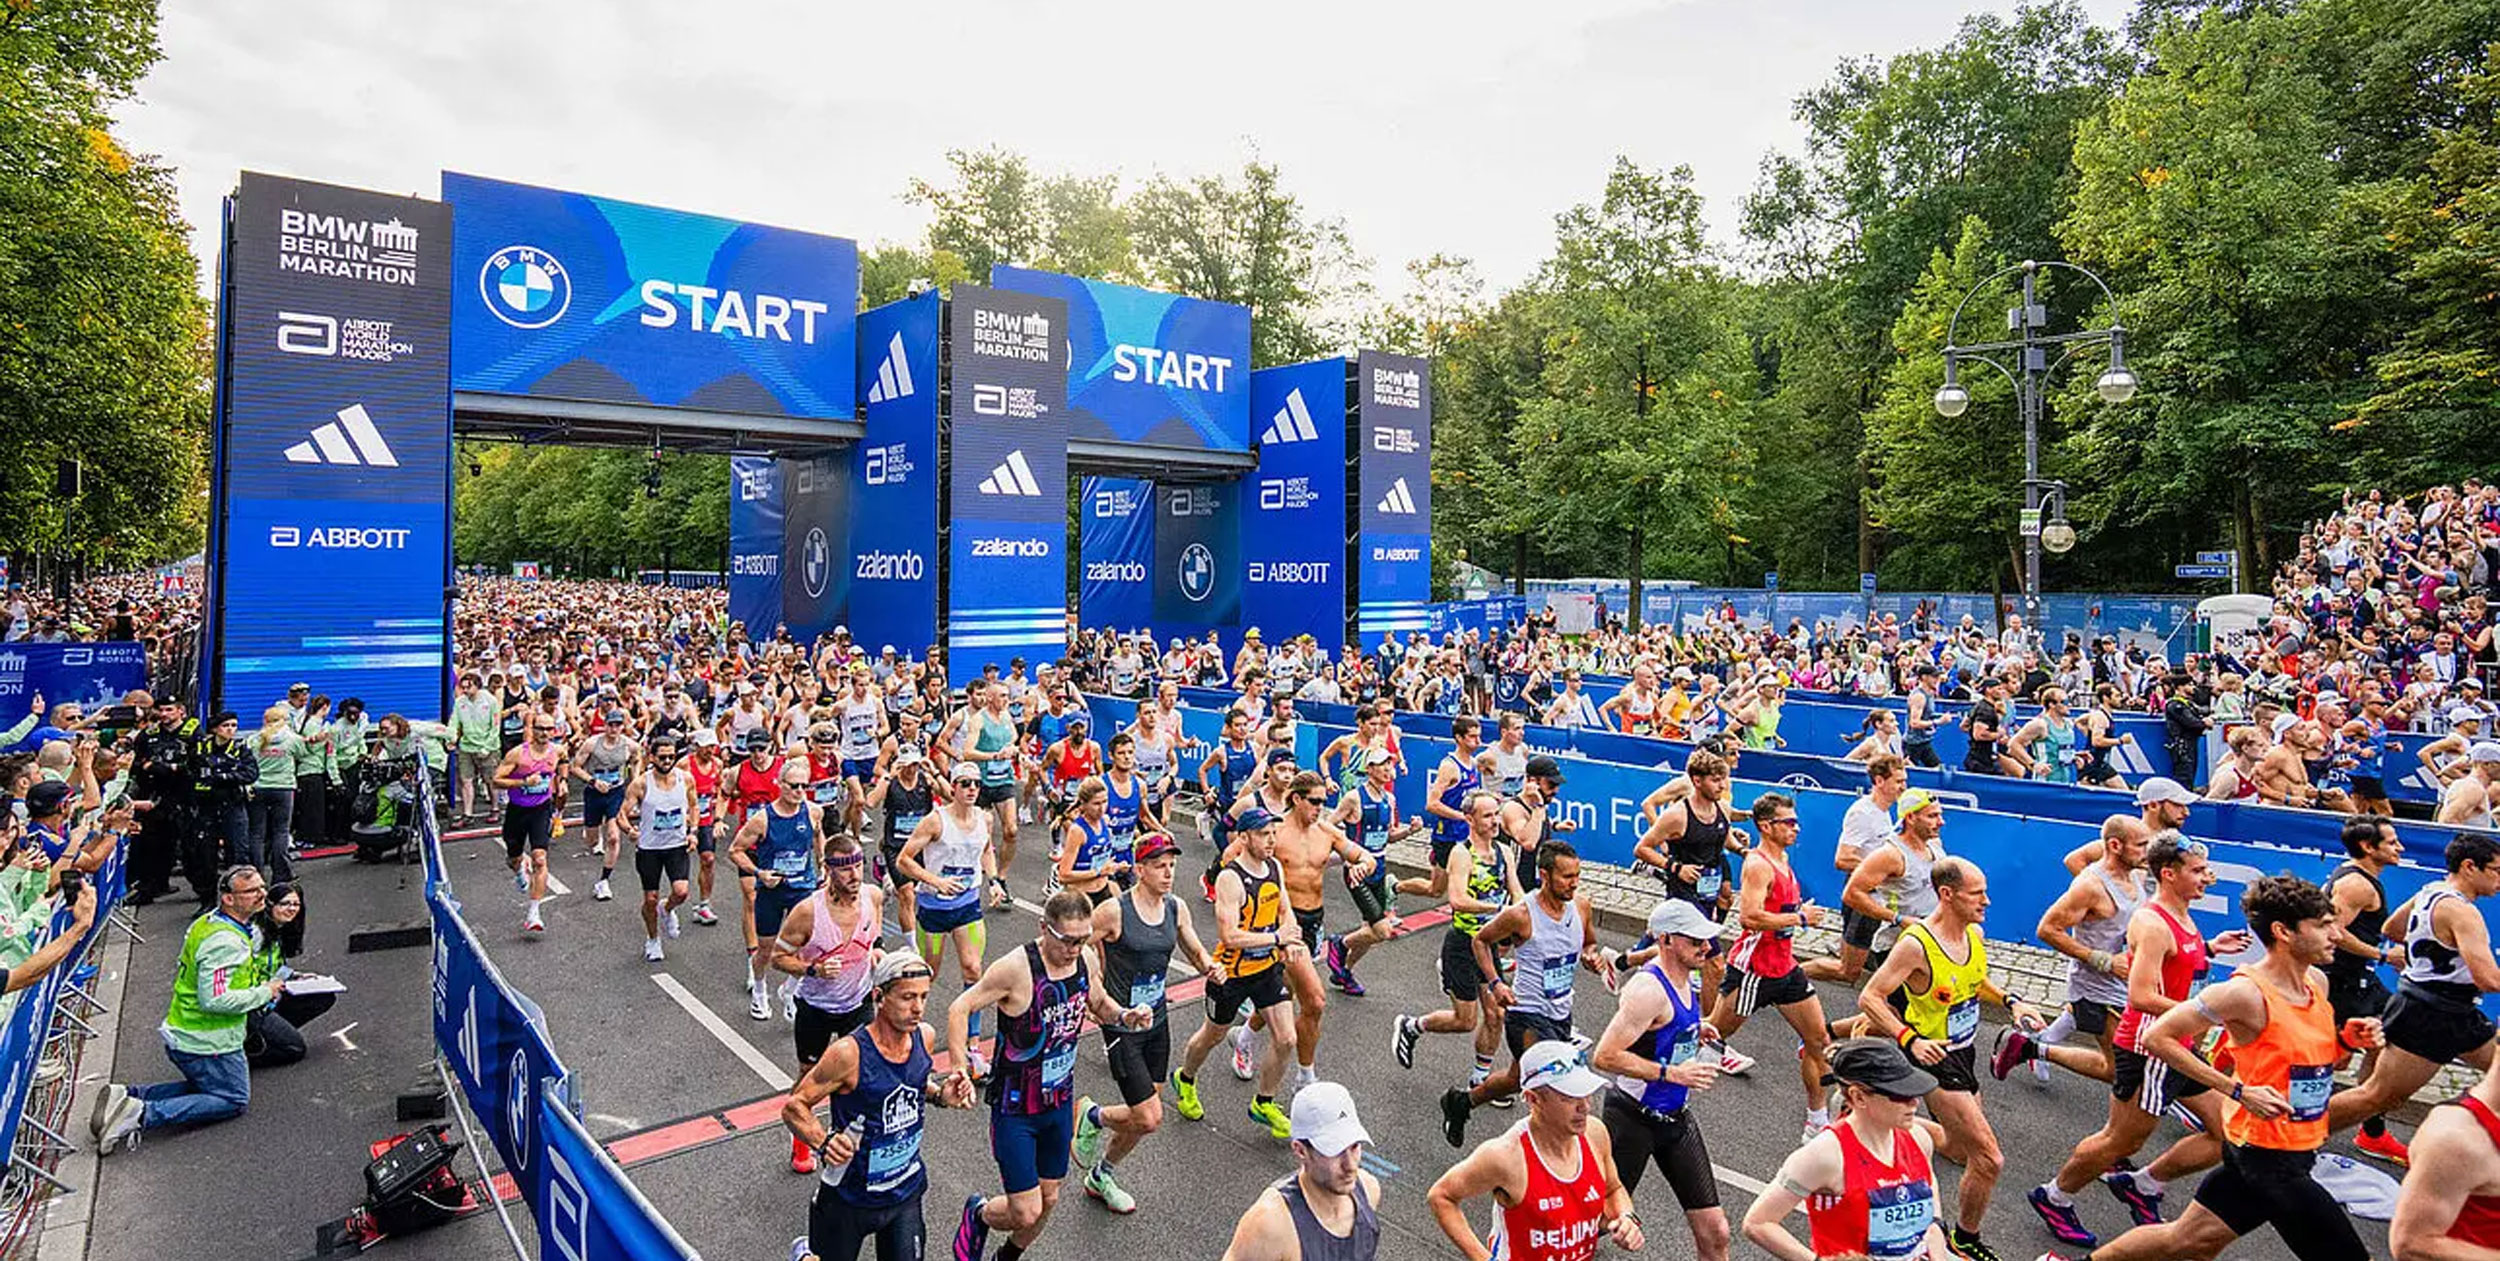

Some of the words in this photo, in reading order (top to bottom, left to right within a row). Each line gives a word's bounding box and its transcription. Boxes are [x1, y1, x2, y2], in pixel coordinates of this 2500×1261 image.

[281, 209, 368, 243] BMW
[280, 235, 368, 261] BERLIN
[279, 253, 416, 286] MARATHON
[493, 250, 560, 278] BMW
[640, 279, 827, 344] START
[974, 309, 1021, 332] BMW
[342, 318, 393, 334] ABBOTT
[342, 329, 390, 342] WORLD
[974, 328, 1022, 345] BERLIN
[341, 337, 413, 354] MARATHON
[341, 348, 393, 361] MAJORS
[973, 341, 1049, 362] MARATHON
[1113, 343, 1232, 393] START
[306, 528, 410, 548] ABBOTT
[971, 537, 1048, 557] zalando
[745, 555, 778, 576] ABBOTT
[857, 550, 923, 580] zalando
[1386, 549, 1421, 561] ABBOTT
[1087, 560, 1145, 582] zalando
[1267, 562, 1330, 583] ABBOTT
[1885, 1202, 1924, 1223] 82123
